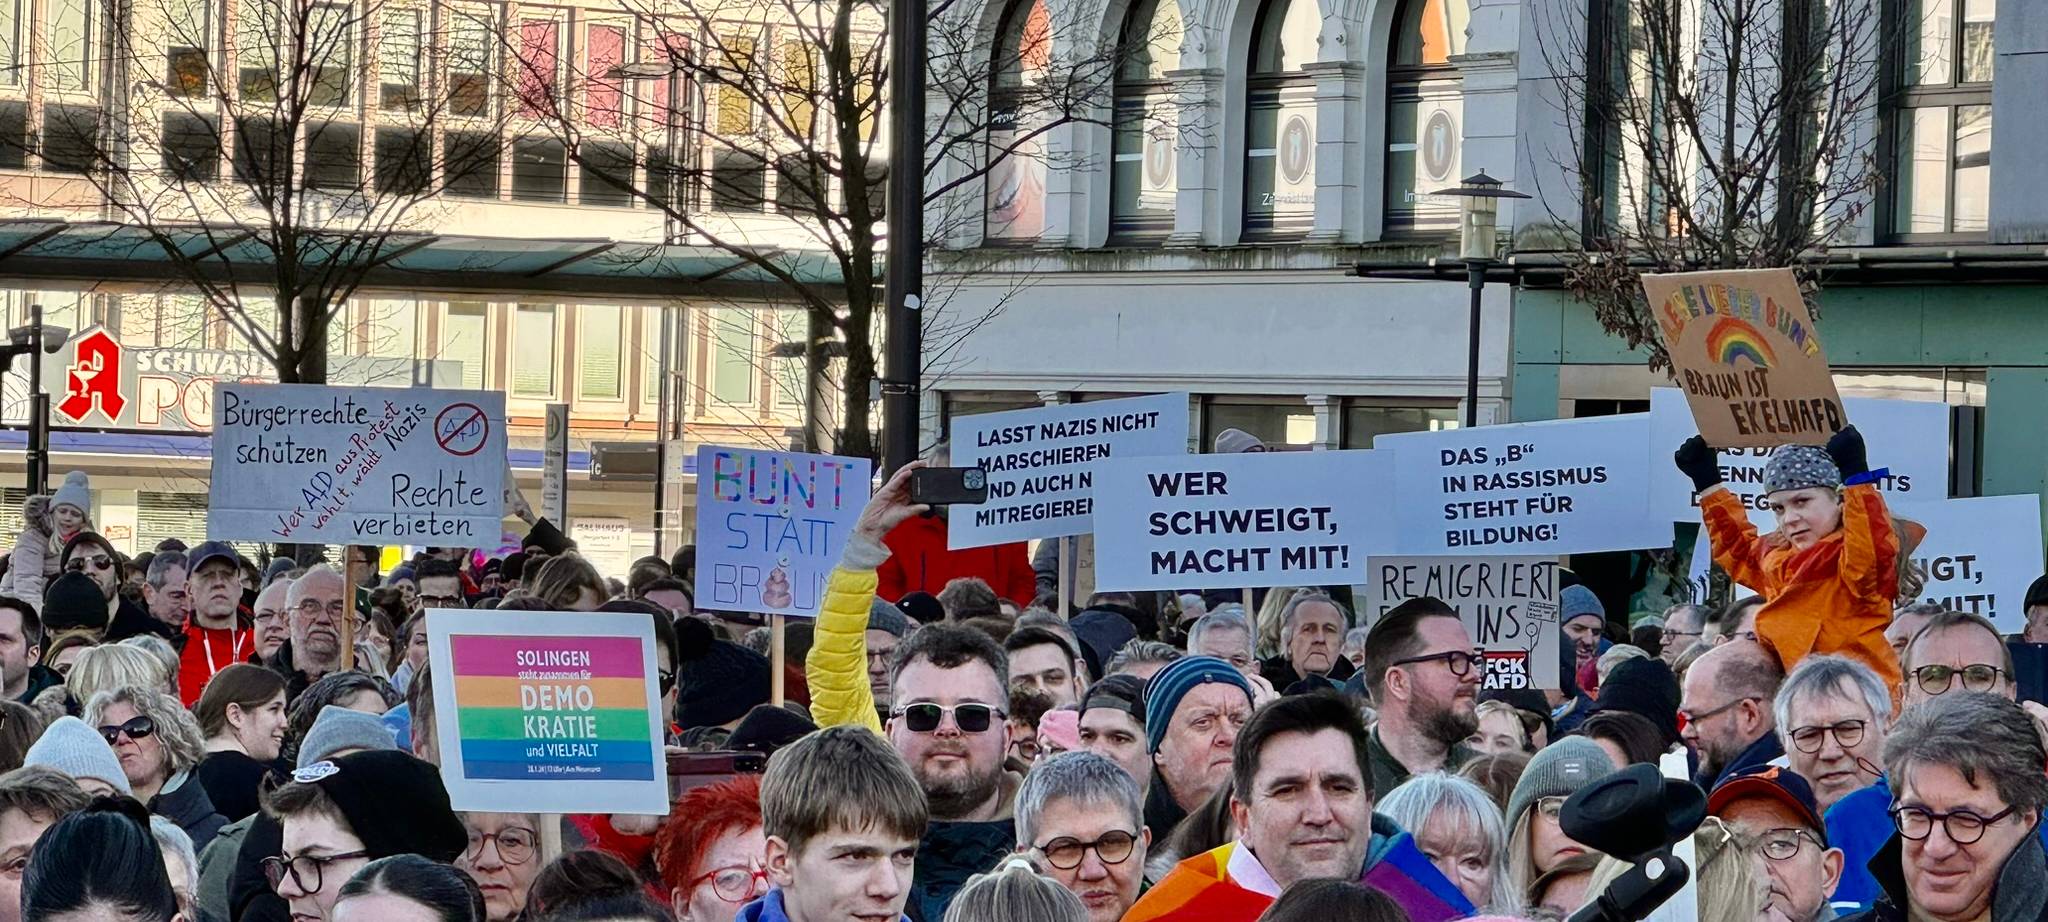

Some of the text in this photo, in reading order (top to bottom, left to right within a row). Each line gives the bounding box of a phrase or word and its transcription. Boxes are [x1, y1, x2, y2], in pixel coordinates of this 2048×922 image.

[1684, 367, 1769, 400] BRAUN IST
[222, 390, 370, 432] Bürgerrechte
[1729, 398, 1841, 436] EKELHAFD
[383, 403, 427, 451] Nazis
[977, 411, 1160, 447] LASST NAZIS NICHT
[236, 434, 327, 464] schützen
[977, 443, 1111, 473] MARSCHIEREN
[1441, 447, 1488, 467] DAS
[271, 400, 400, 537] Wer AfD aus Protest
[714, 452, 853, 510] BUNT
[1443, 466, 1608, 493] IN RASSISMUS
[1717, 466, 1764, 483] ENN
[391, 469, 488, 507] Rechte
[986, 480, 1016, 499] ND
[1021, 471, 1073, 496] AUCH
[1147, 471, 1229, 497] WER
[1149, 506, 1337, 536] SCHWEIGT,
[1444, 492, 1573, 520] STEHT FÜR
[353, 511, 473, 536] verbieten
[726, 512, 836, 557] STATT
[1446, 523, 1558, 547] BILDUNG!
[1151, 545, 1349, 575] MACHT MIT!
[1382, 561, 1559, 601] REMIGRIERT
[1476, 604, 1521, 645] INS
[516, 650, 591, 667] SOLINGEN
[1485, 657, 1526, 674] FCK
[1483, 674, 1528, 690] AFD
[520, 684, 594, 711] DEMO
[523, 715, 598, 739] KRATIE
[526, 743, 599, 757] und VIELFALT
